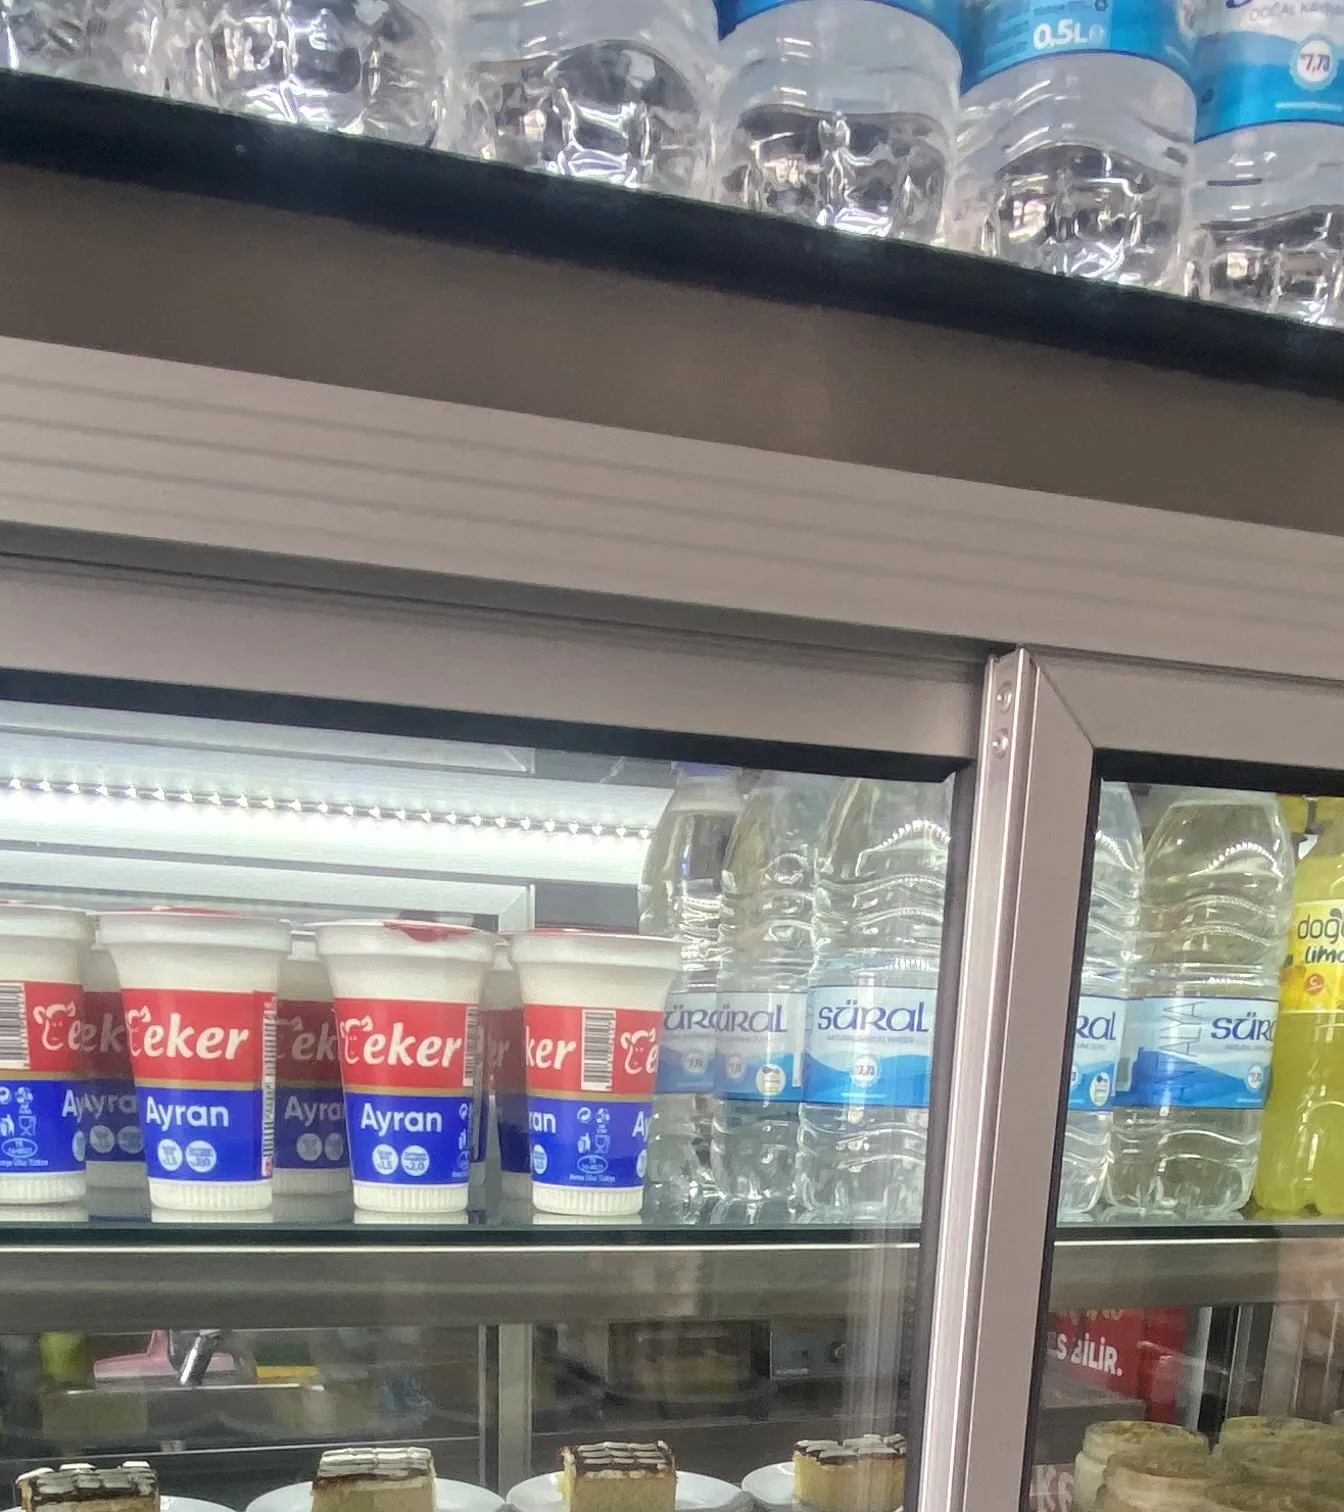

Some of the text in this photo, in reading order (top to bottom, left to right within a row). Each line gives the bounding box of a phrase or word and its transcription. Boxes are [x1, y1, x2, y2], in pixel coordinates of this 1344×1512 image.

[146, 1096, 229, 1131] Ayran
[284, 1096, 344, 1126] Ayra
[361, 1103, 443, 1137] Ayran
